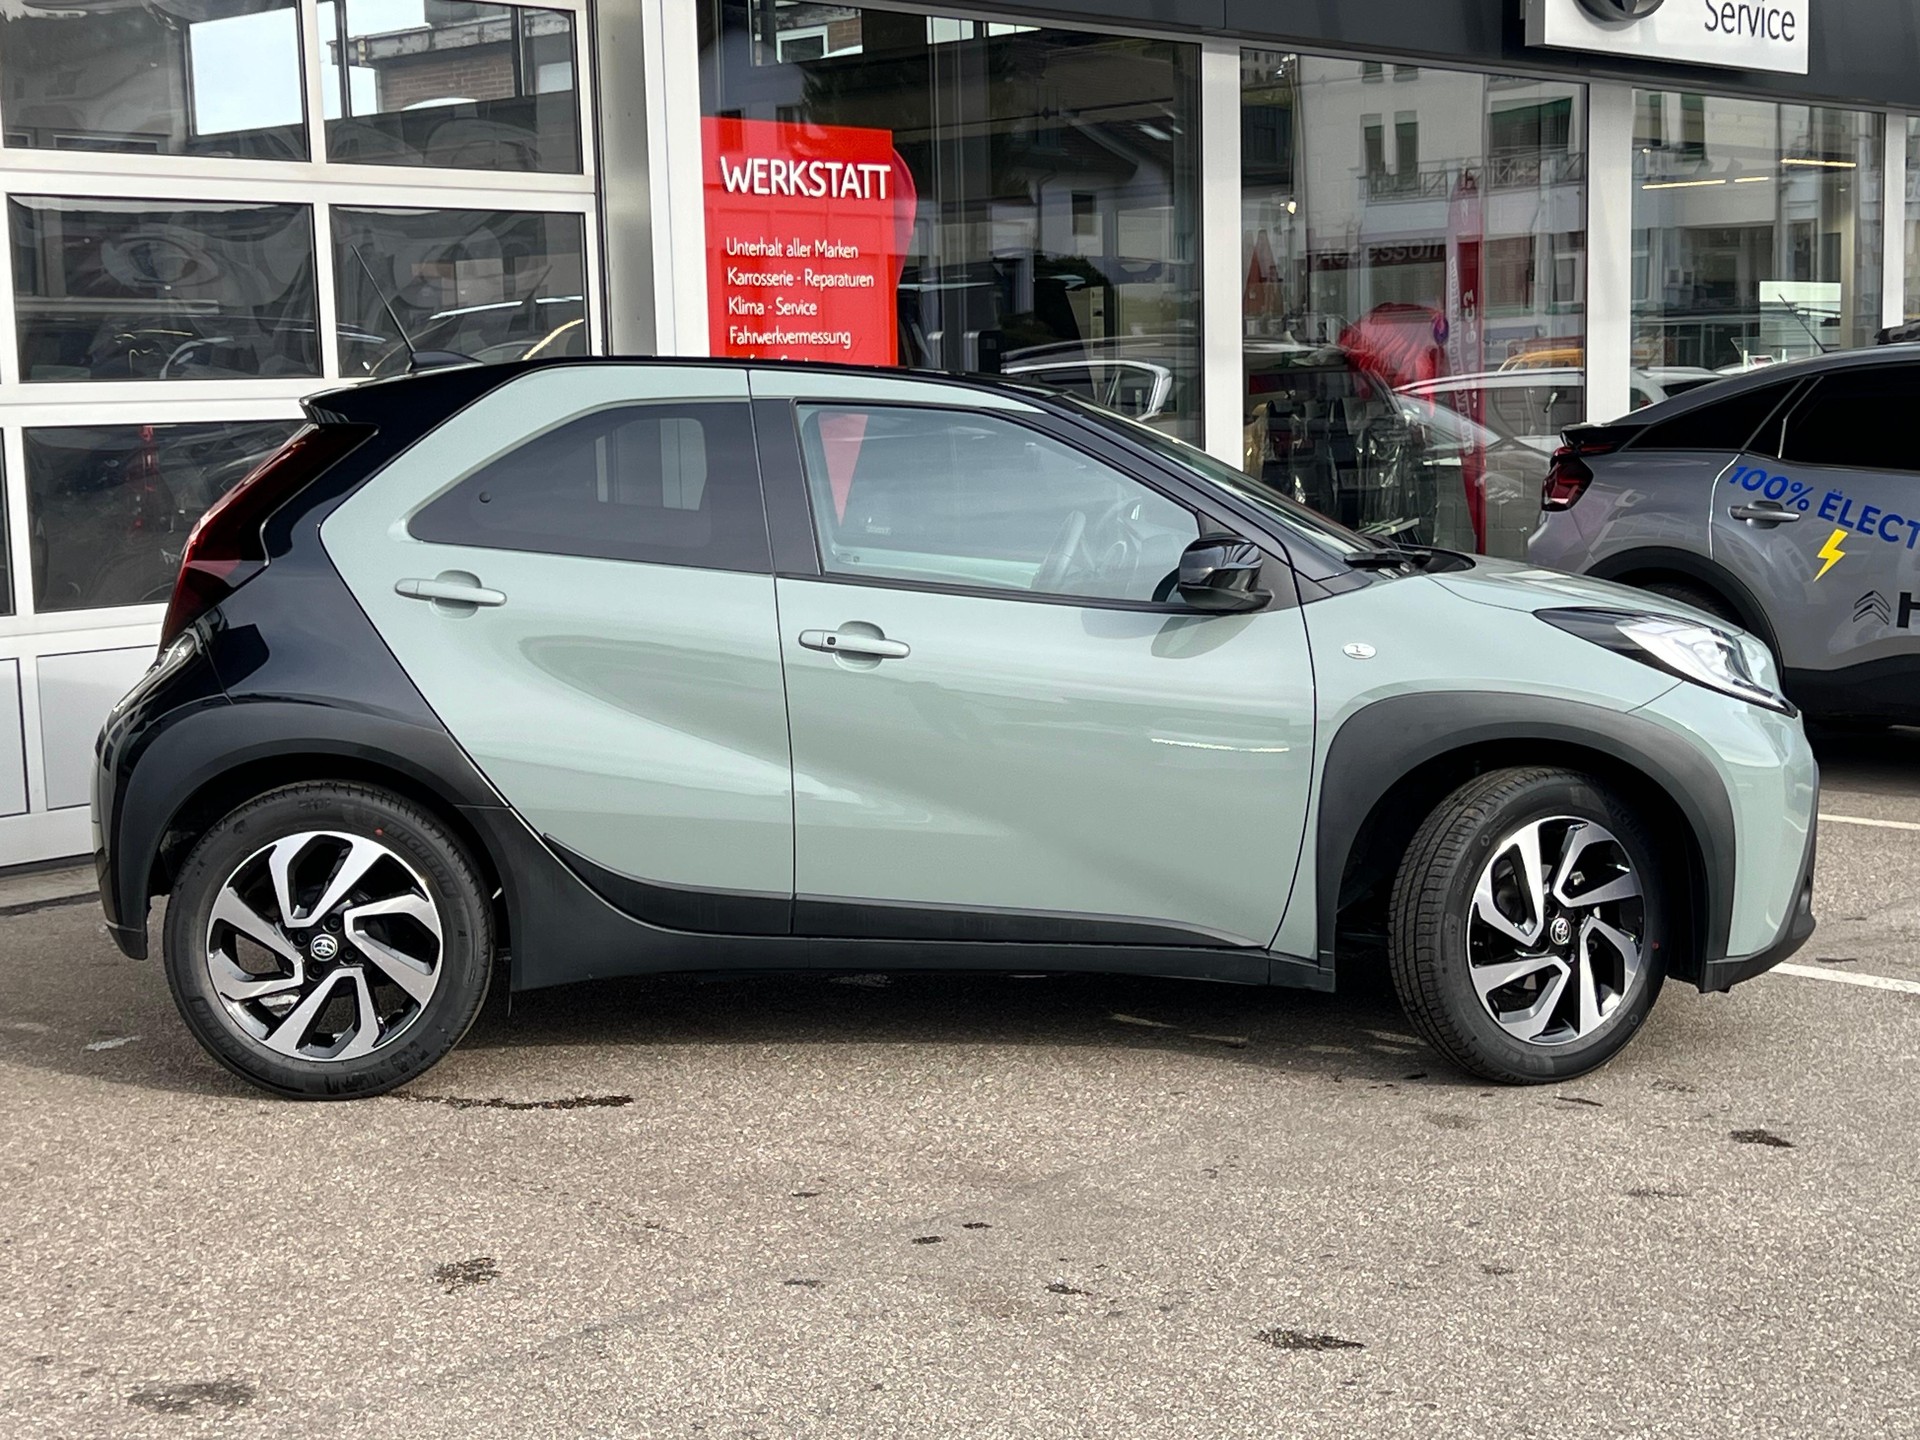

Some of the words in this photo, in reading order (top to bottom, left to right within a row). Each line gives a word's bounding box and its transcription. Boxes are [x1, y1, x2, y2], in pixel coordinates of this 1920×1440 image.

[1704, 0, 1795, 42] Service
[720, 156, 891, 199] WERKSTATT
[726, 236, 783, 257] Unterhalt
[786, 237, 811, 257] aller
[815, 239, 858, 258] Marken
[727, 266, 794, 287] Karrosserie
[804, 268, 874, 291] Reparaturen
[728, 295, 765, 315] Klima
[775, 296, 818, 316] Service
[729, 325, 851, 350] Fahrwerkvermessung
[1729, 466, 1814, 512] 100%
[1817, 488, 1920, 549] ËLECT
